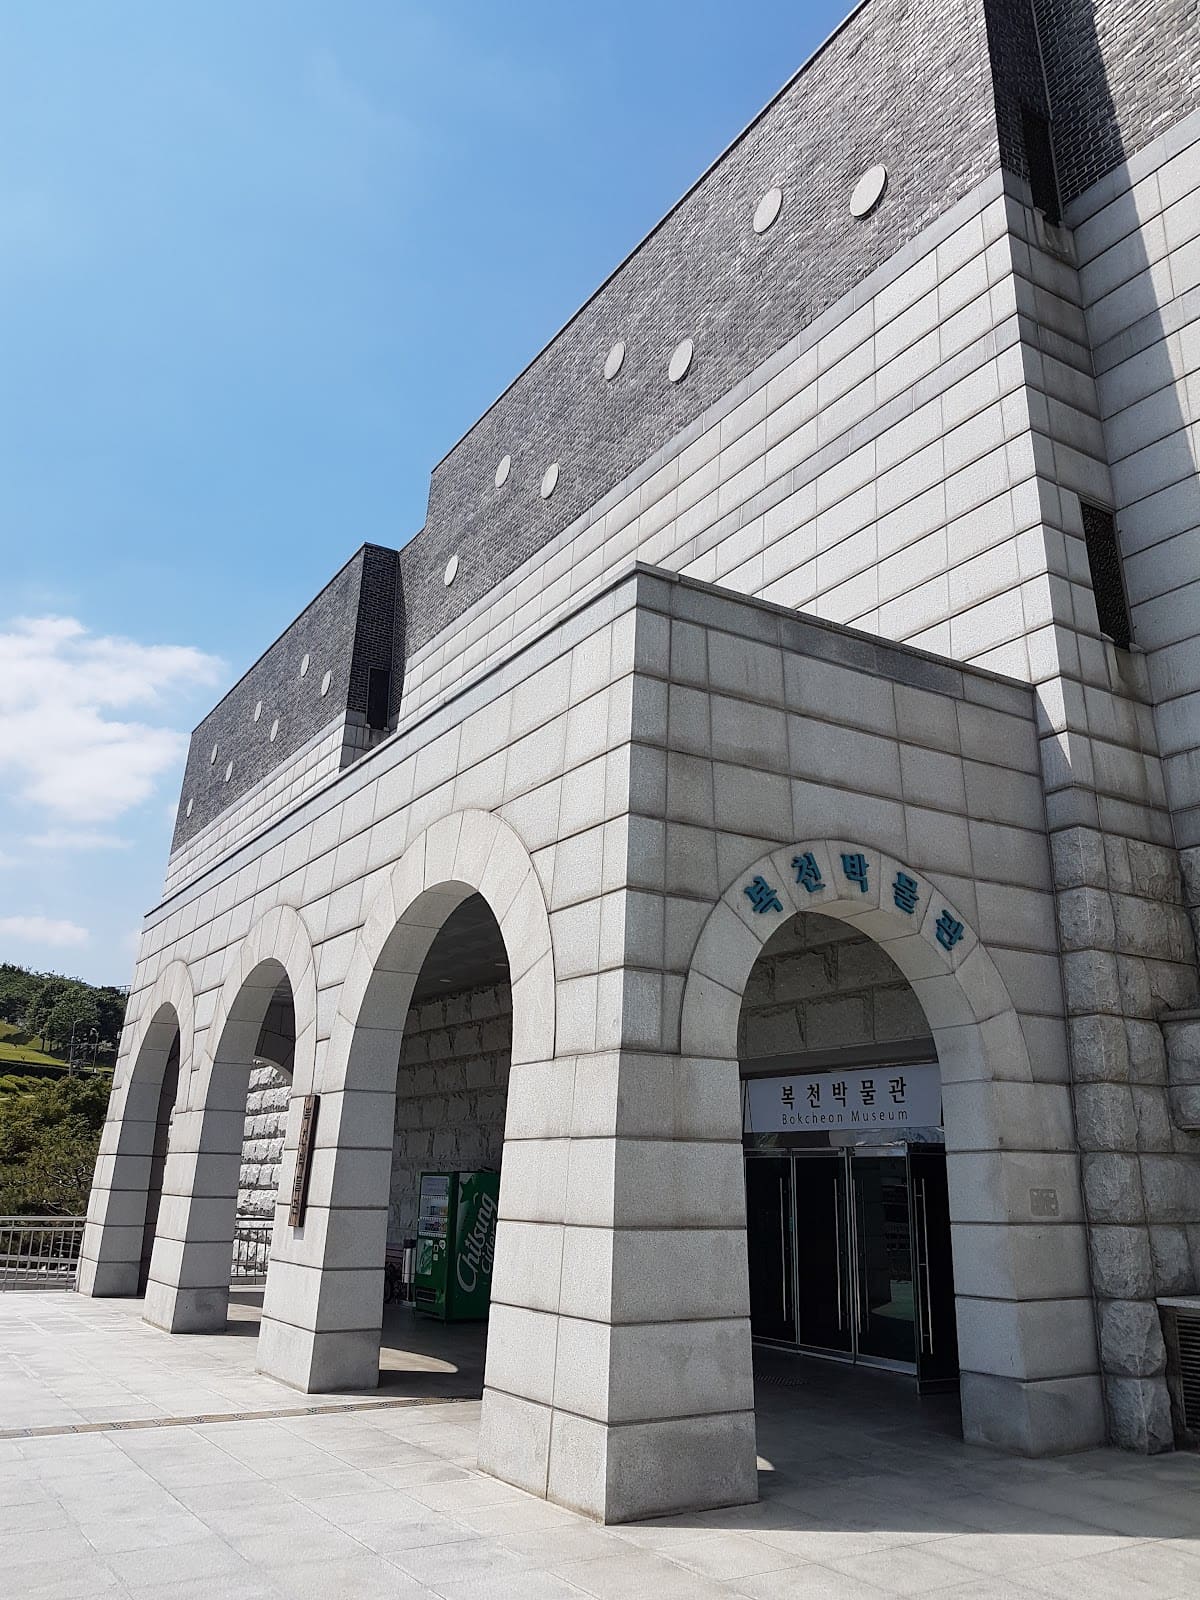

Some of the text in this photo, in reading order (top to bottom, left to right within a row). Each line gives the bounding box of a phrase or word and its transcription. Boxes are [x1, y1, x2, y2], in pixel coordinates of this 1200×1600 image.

[743, 852, 965, 951] 복천박물관
[781, 1077, 907, 1110] 복천박물관
[782, 1109, 908, 1125] Bokcheon Museum
[457, 1192, 498, 1293] Chilsung
